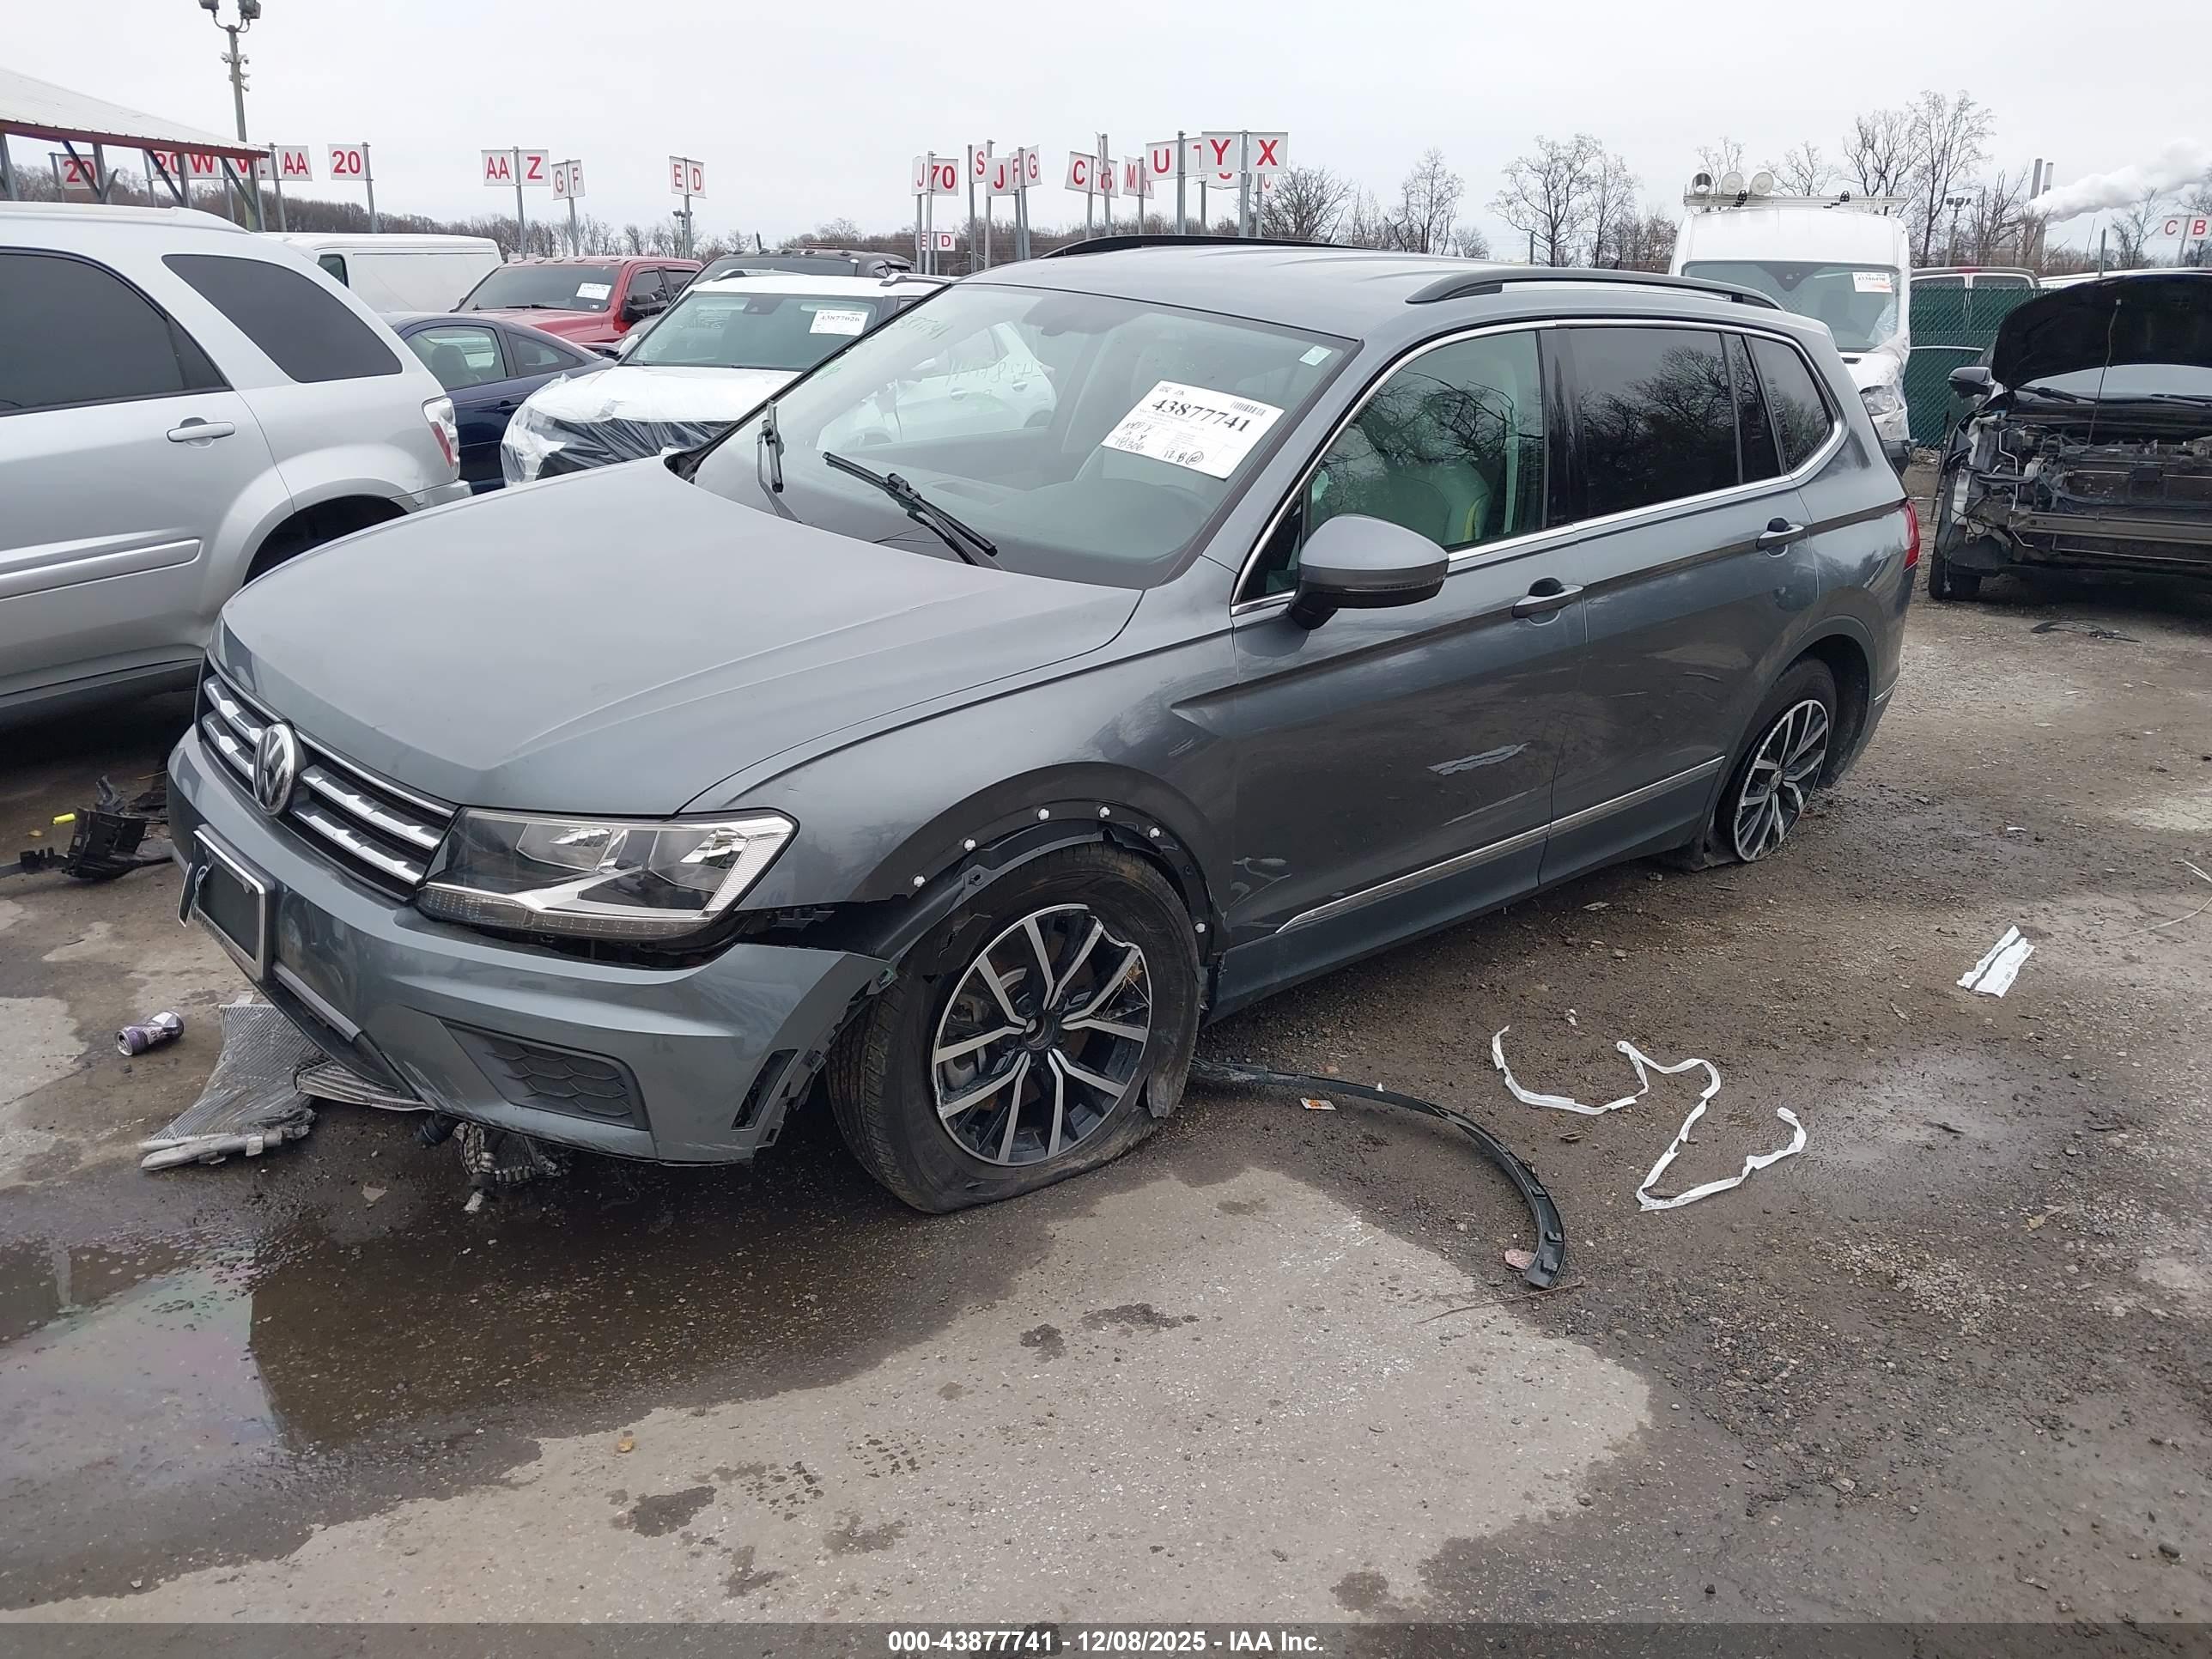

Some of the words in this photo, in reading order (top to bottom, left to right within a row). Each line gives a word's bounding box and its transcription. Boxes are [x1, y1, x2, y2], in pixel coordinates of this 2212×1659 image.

[189, 152, 214, 173] W
[283, 151, 308, 175] AA
[332, 150, 361, 173] 20
[975, 151, 986, 175] S
[1154, 149, 1170, 173] U
[1210, 139, 1231, 165] Y
[1256, 139, 1278, 166] X
[486, 156, 510, 179] AA
[527, 156, 543, 179] Z
[673, 164, 683, 188] E
[693, 168, 702, 191] D
[916, 163, 925, 187] J
[994, 165, 1005, 189] J
[1028, 153, 1037, 179] G
[1073, 160, 1086, 185] C
[1127, 163, 1136, 189] M
[555, 170, 564, 193] G
[570, 167, 579, 190] F
[2165, 220, 2179, 235] C
[2192, 220, 2208, 235] B
[941, 234, 951, 247] D
[1152, 398, 1251, 433] 43877741
